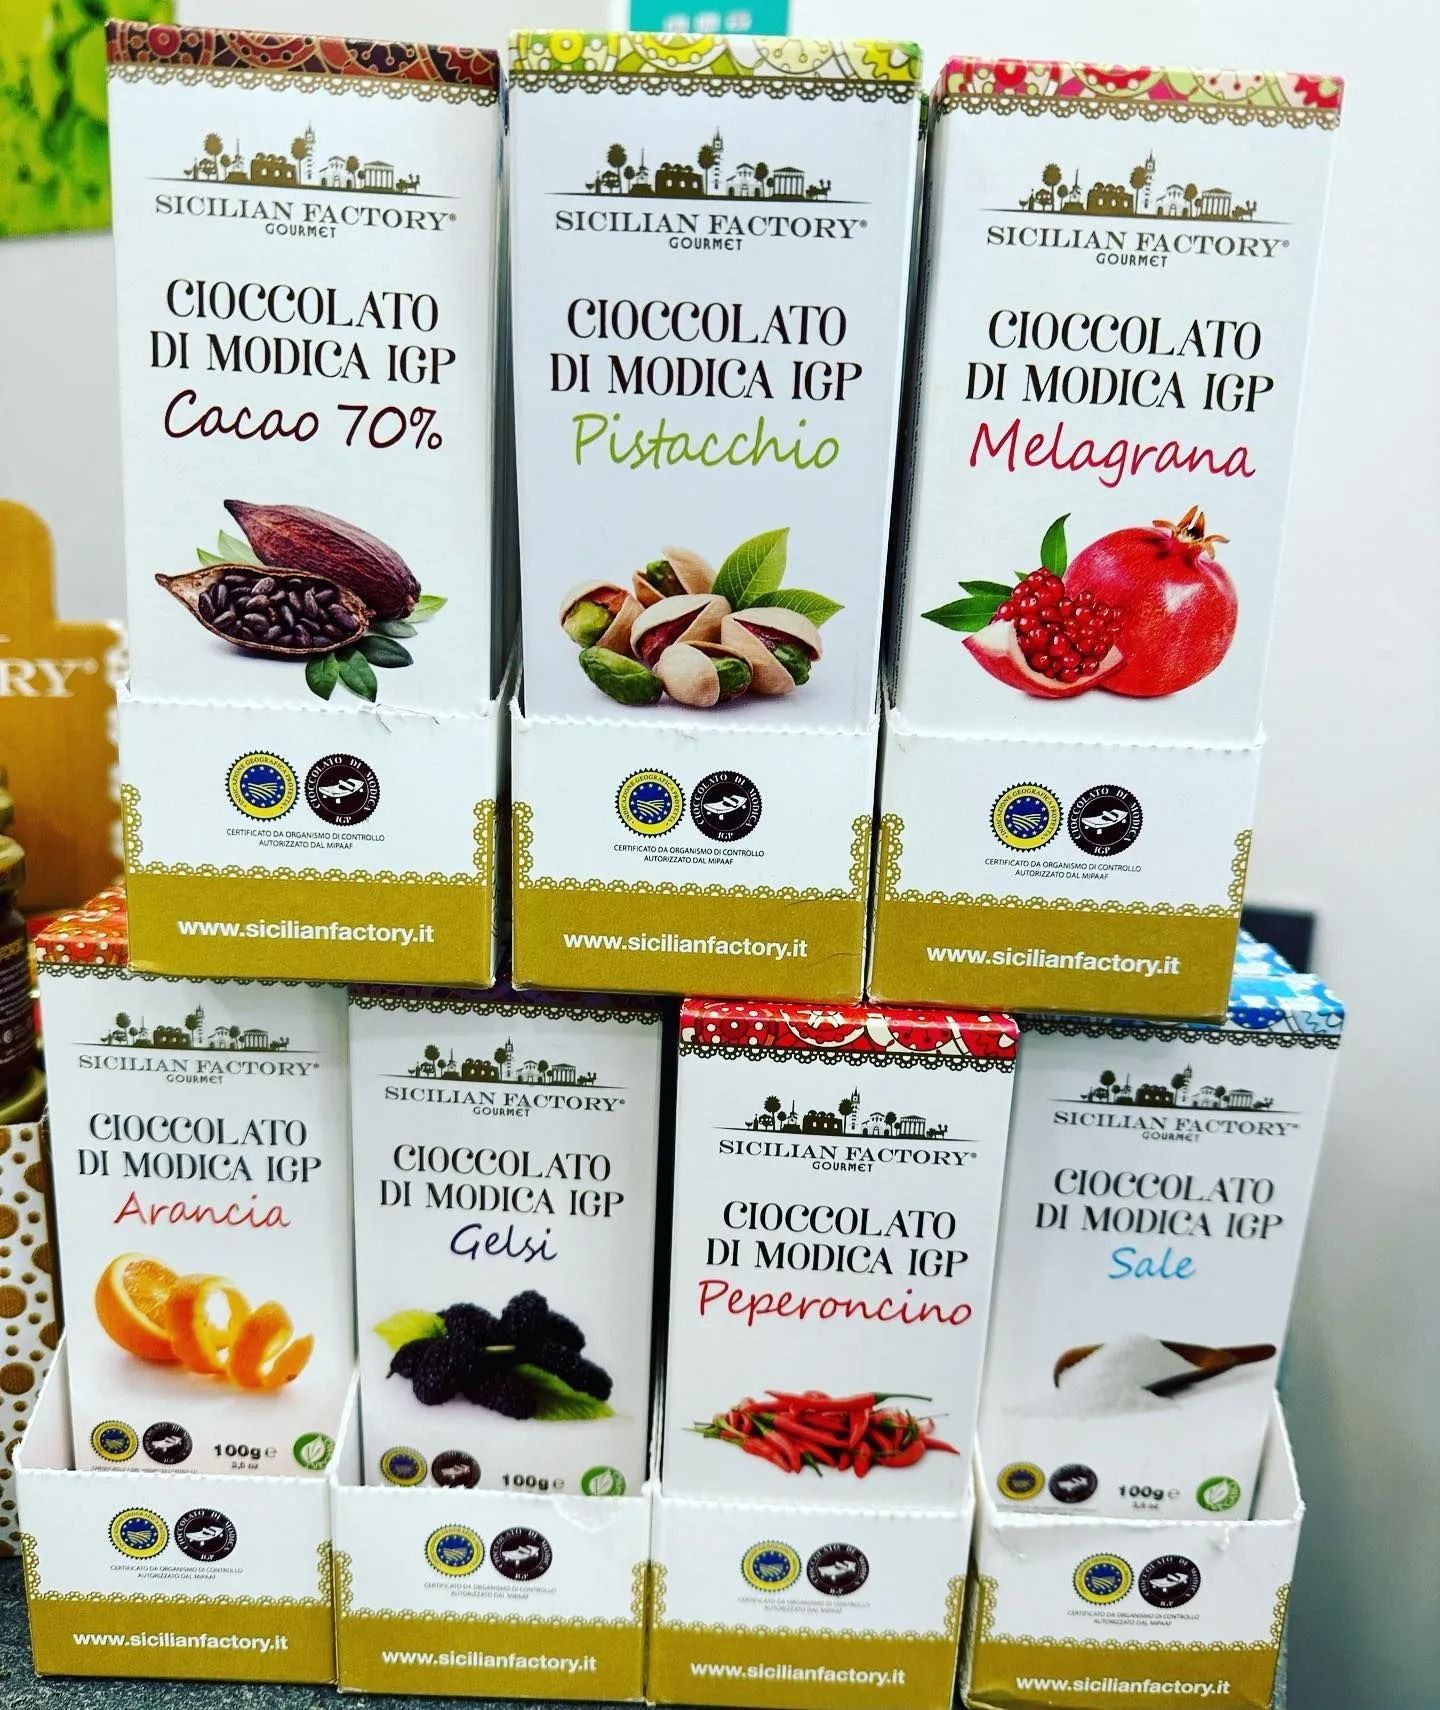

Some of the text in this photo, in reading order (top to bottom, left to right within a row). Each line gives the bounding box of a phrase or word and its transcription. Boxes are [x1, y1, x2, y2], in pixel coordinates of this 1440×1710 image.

[155, 194, 292, 221] SICILIAN
[265, 223, 336, 239] GOURMET
[555, 210, 696, 234] SICILIAN
[669, 237, 742, 251] GOURMET
[988, 226, 1127, 250] SICILIAN
[1096, 253, 1168, 268] GOURMET
[167, 279, 439, 332] CIOCCOLATO
[567, 299, 847, 346] CIOCCOLATO
[988, 309, 1261, 360] CIOCCOLATO
[150, 331, 456, 384] DI MODICA IGP
[551, 353, 862, 401] DI MODICA IGP
[966, 362, 1274, 412] DI MODICA IGP
[164, 389, 442, 450] Cacao 70%
[573, 413, 839, 470] Pistacchio
[970, 418, 1255, 488] Melagrana
[245, 756, 287, 775] GEOGRAFICA
[308, 757, 376, 811] CIOCCOLATO DI MODICA
[635, 774, 674, 791] GEOGRAFICA
[693, 774, 759, 827] CIOCCOLATO DI MODICA
[1013, 788, 1052, 805] GEOGRAFICA
[1071, 788, 1140, 841] CIOCCOLATO DI MODICA
[227, 829, 271, 838] CERTIFICATO
[274, 830, 284, 838] DA
[285, 830, 330, 841] ORGANISMO
[342, 833, 385, 842] CONTROLLO
[259, 839, 353, 849] AUTORIZZATO DAL MIPAAF
[614, 845, 656, 853] CERTIFICATO
[669, 847, 712, 856] ORGANISMO
[722, 848, 764, 857] CONTROLLO
[644, 855, 733, 866] AUTORIZZATO DAL MIPAAF
[985, 858, 1028, 867] CERTIFICATO
[1043, 861, 1087, 870] ORGANISMO
[1098, 864, 1141, 873] CONTROLLO
[1015, 869, 1108, 880] AUTORIZZATO DAL MIPAAF
[178, 919, 434, 946] www.sicilianfactory.it
[564, 933, 807, 961] www.sicilianfactory.it
[927, 946, 1180, 976] www.sicilianfactory.it
[79, 1055, 188, 1072] SICILIAN
[167, 1074, 223, 1084] GOURMET
[385, 1086, 495, 1104] SICILIAN
[473, 1106, 530, 1117] GOURMET
[1053, 1111, 1168, 1130] SICILIAN
[90, 1113, 307, 1147] CIOCCOLATO
[1142, 1132, 1200, 1142] GOURMET
[719, 1139, 837, 1159] SICILIAN
[78, 1149, 321, 1182] DI MODICA IGP
[394, 1144, 611, 1181] CIOCCOLATO
[812, 1161, 874, 1172] GOURMET
[1054, 1168, 1273, 1204] CIOCCOLATO
[114, 1190, 290, 1228] Arancia
[380, 1180, 624, 1217] DI MODICA IGP
[723, 1201, 956, 1239] CIOCCOLATO
[1035, 1202, 1283, 1240] DI MODICA IGP
[450, 1223, 558, 1263] Gelsi
[706, 1238, 968, 1278] DI MODICA IGP
[1108, 1247, 1196, 1280] Sale
[698, 1279, 972, 1327] Peperoncino
[214, 1444, 261, 1459] 100g
[501, 1474, 549, 1491] 100g
[1118, 1485, 1164, 1500] 100g
[73, 1633, 288, 1653] www.sicilianfactory.it
[383, 1650, 596, 1672] www.sicilianfactory.it
[690, 1662, 906, 1685] www.sicilianfactory.it
[1016, 1676, 1230, 1696] www.sicilianfactory.it
